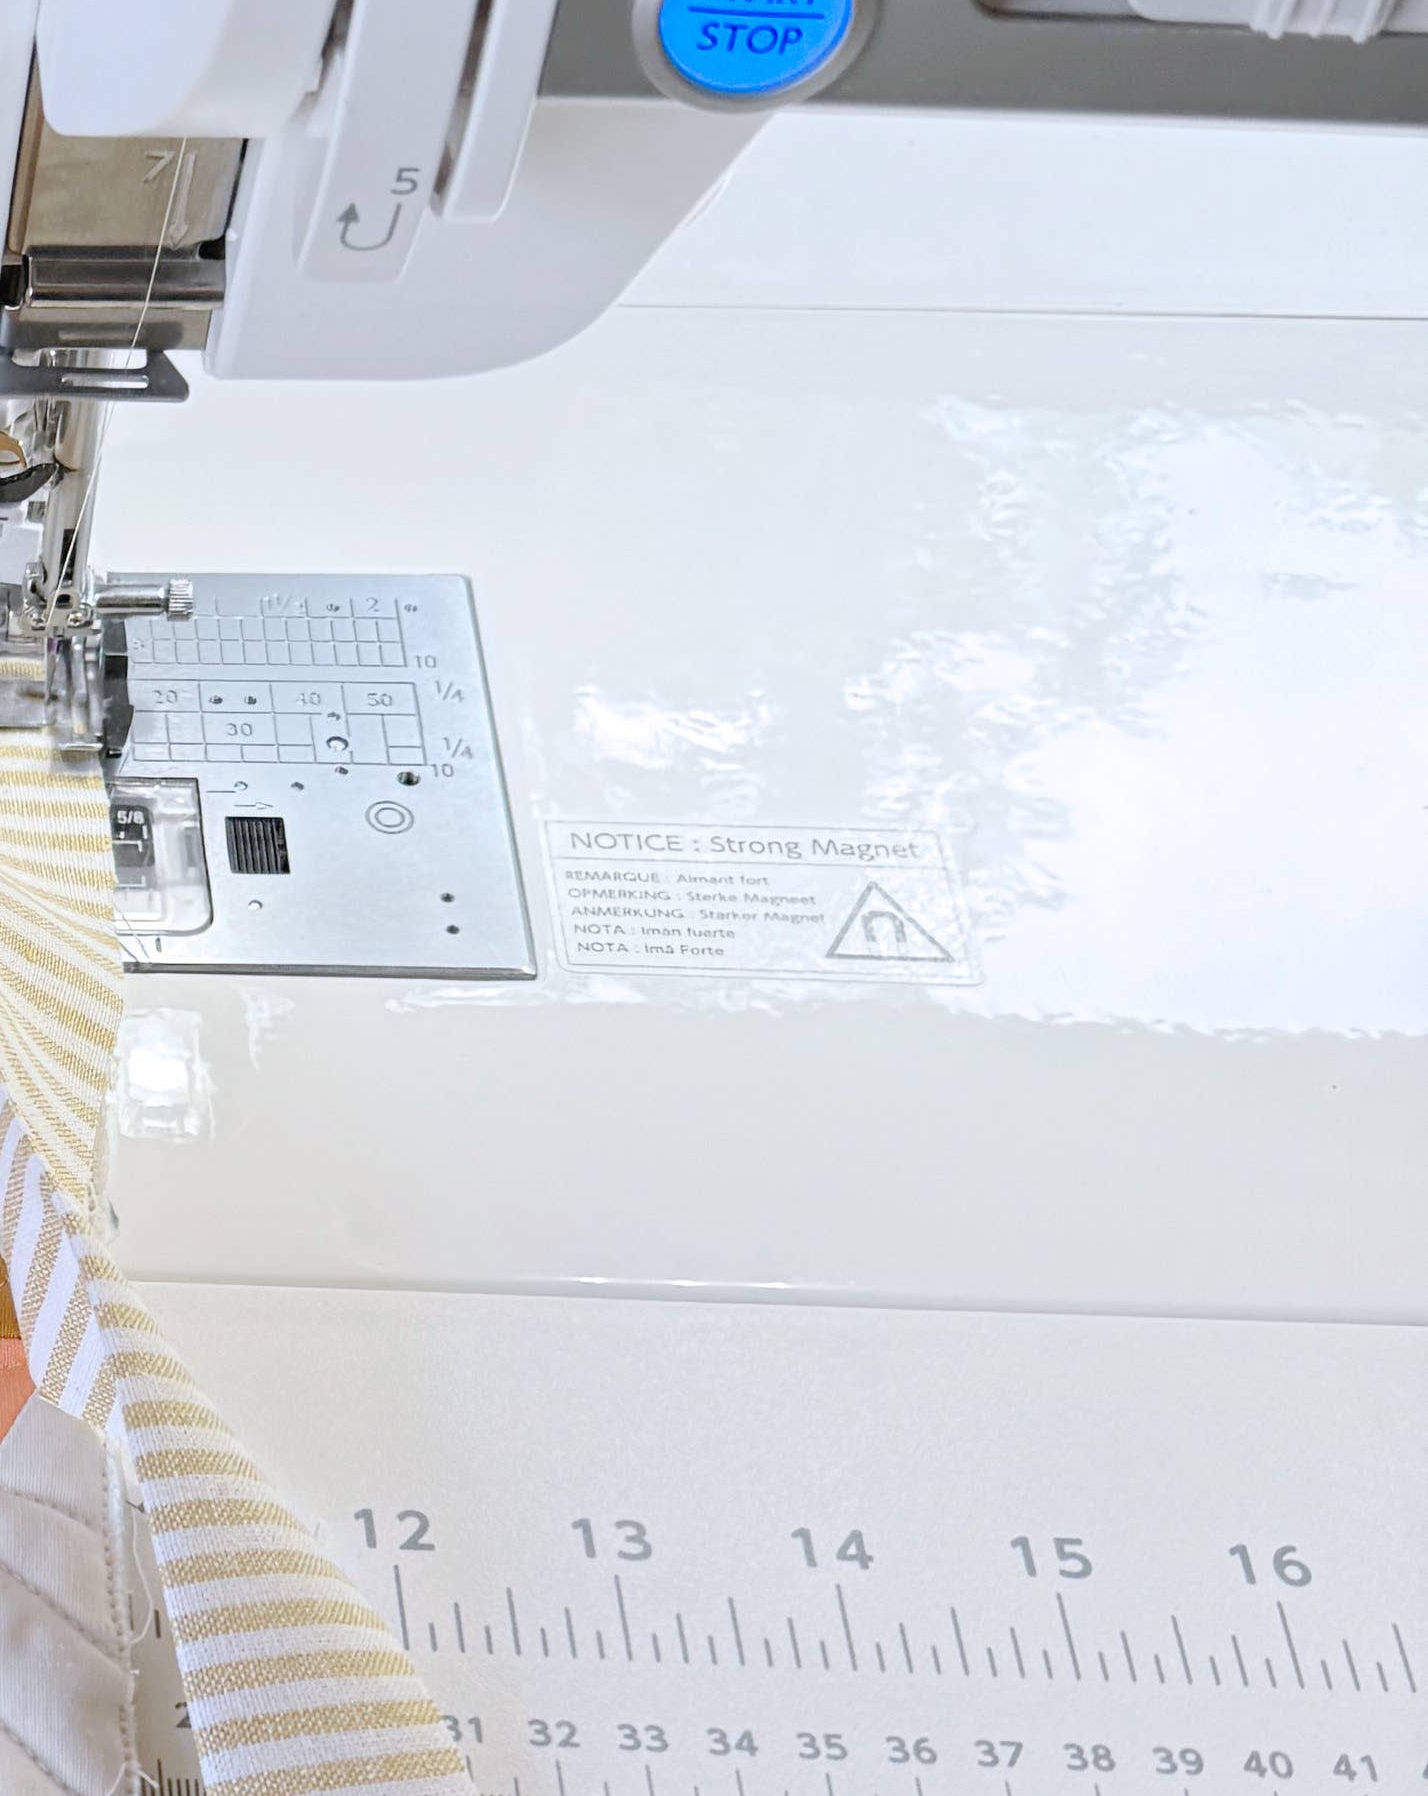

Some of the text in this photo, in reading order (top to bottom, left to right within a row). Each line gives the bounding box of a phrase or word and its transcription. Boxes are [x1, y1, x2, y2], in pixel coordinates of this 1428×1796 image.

[696, 22, 804, 55] STOP
[144, 150, 176, 183] 7
[390, 167, 420, 195] 5
[366, 597, 380, 612] 2
[415, 654, 437, 669] 10
[366, 692, 393, 707] 50
[226, 722, 253, 737] 30
[430, 763, 455, 778] 10
[570, 832, 684, 852] NOTICE
[709, 835, 803, 860] Strong
[812, 838, 920, 862] Magnet
[565, 870, 661, 883] REMARQUE
[676, 873, 734, 886] Aimant
[740, 874, 769, 886] fort
[567, 887, 672, 902] OPMERKING
[685, 891, 738, 904] Sterke
[743, 892, 817, 907] Magneet
[571, 905, 685, 919] ANMERKUNG
[698, 909, 758, 922] Starker
[763, 911, 826, 925] Magnet
[574, 923, 626, 936] NOTA
[687, 926, 736, 939] fuerte
[577, 941, 629, 953] NOTA
[680, 944, 725, 956] Forte
[353, 1508, 1312, 1588] 12 13 14 15 16
[528, 1718, 581, 1748] 32
[617, 1723, 669, 1753] 33
[707, 1728, 759, 1757] 34
[796, 1732, 848, 1761] 35
[885, 1736, 938, 1765] 36
[973, 1739, 1024, 1768] 37
[1063, 1742, 1116, 1773] 38
[1151, 1746, 1204, 1776] 39
[1242, 1749, 1295, 1781] 40
[1331, 1752, 1379, 1783] 41
